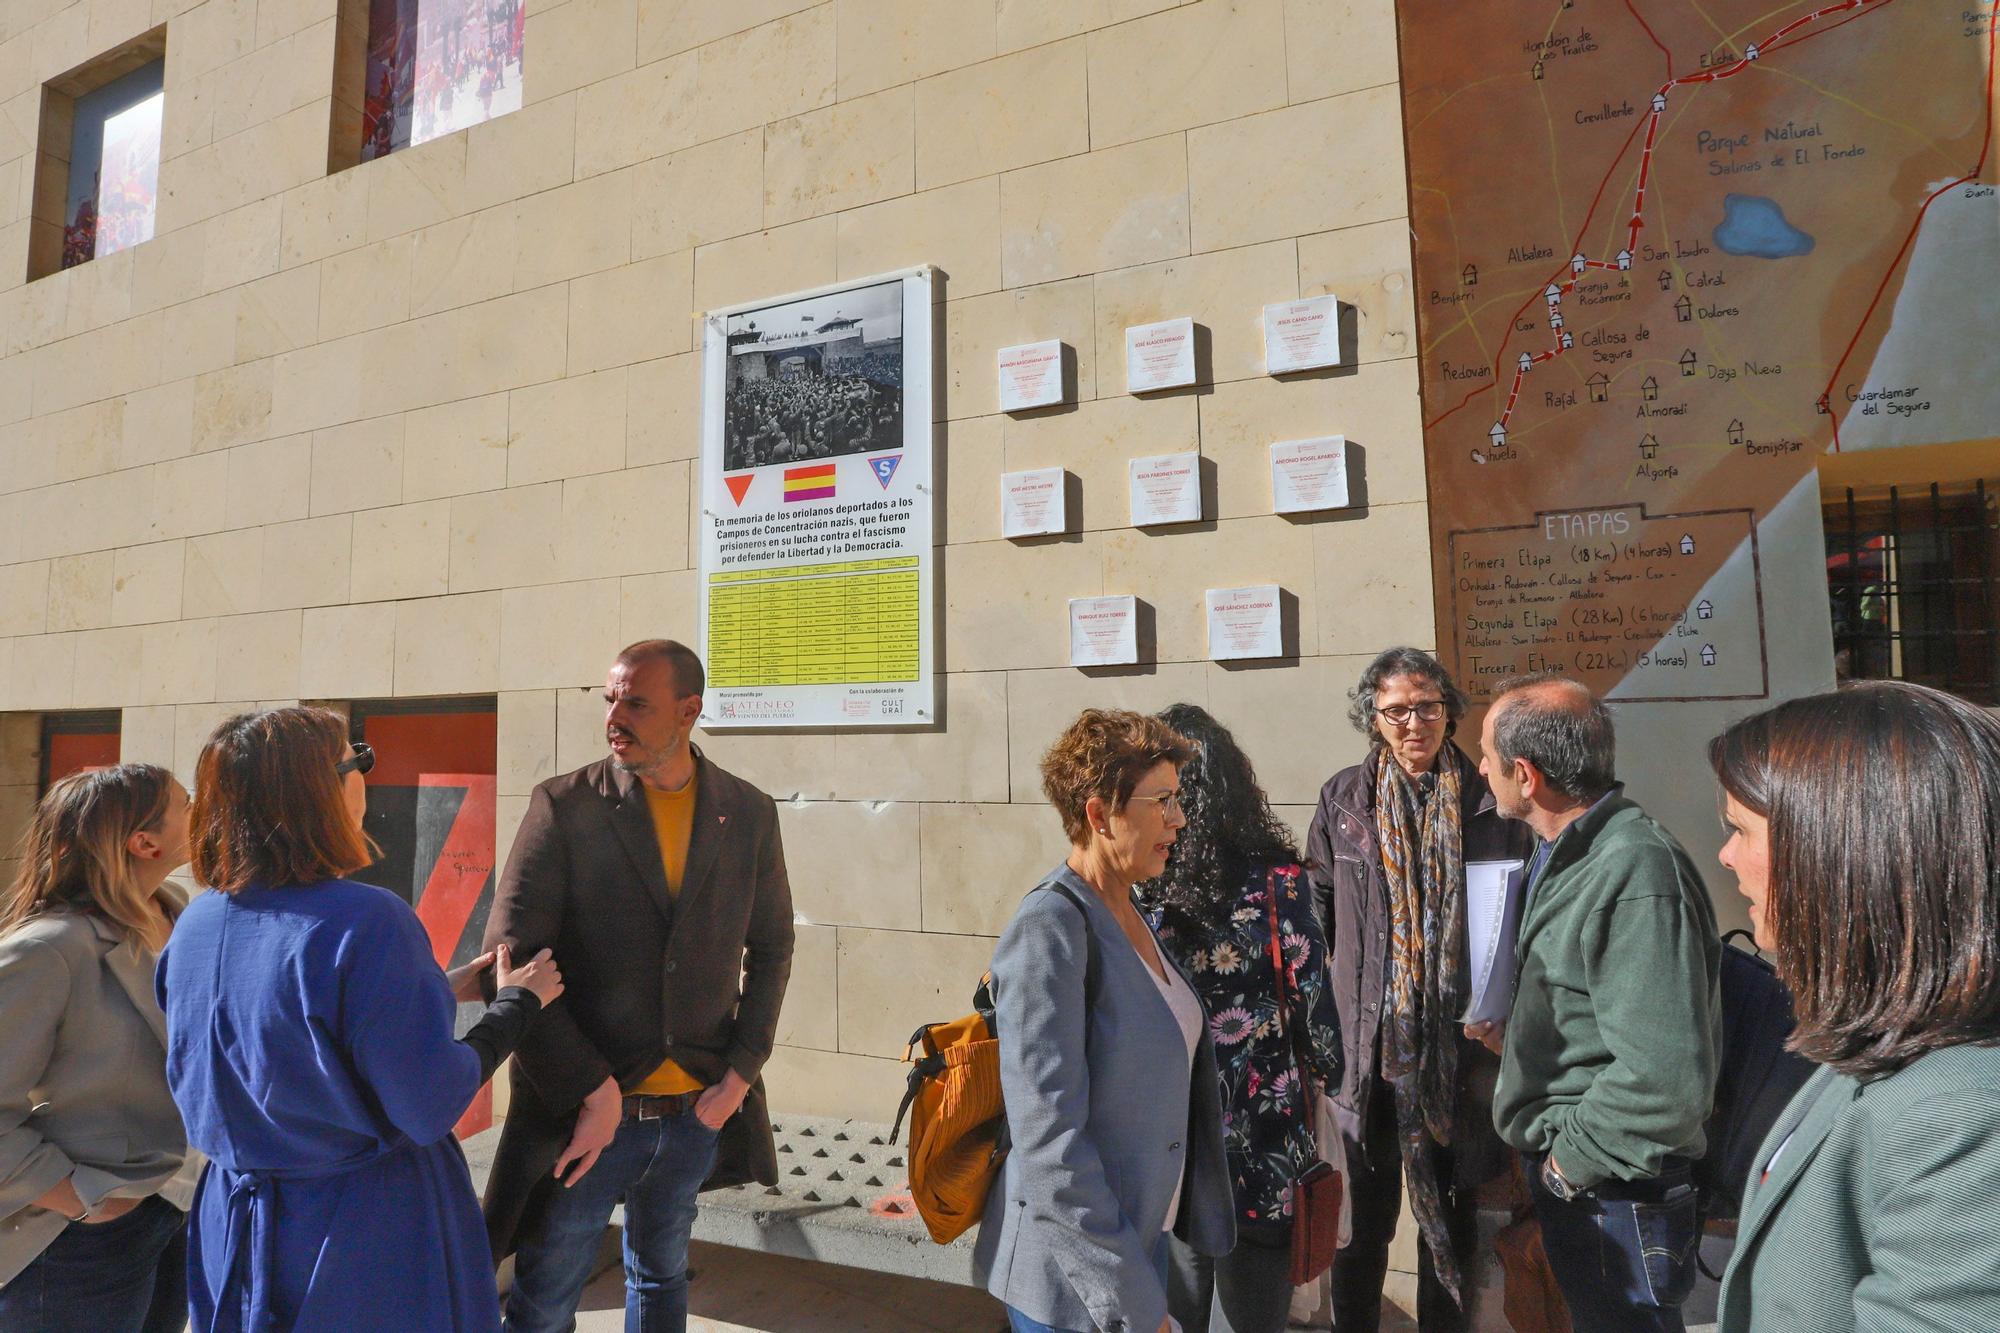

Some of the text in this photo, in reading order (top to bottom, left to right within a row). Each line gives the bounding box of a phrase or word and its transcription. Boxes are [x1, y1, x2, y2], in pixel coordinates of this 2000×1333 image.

[1576, 26, 1592, 42] de
[1700, 51, 1735, 68] Elche
[1575, 100, 1635, 125] Crevillente
[1696, 121, 1822, 155] Parque Natural
[1709, 143, 1866, 176] Salinas de El Fondo
[1964, 187, 1995, 199] Santa
[1507, 244, 1553, 264] Albatera
[1642, 240, 1710, 262] San Isidro
[1574, 277, 1630, 296] Granja de
[1684, 270, 1726, 288] Catral
[1431, 289, 1475, 306] Benferri
[1579, 291, 1632, 305] Rocamora
[1697, 304, 1739, 320] Dolores
[1515, 318, 1536, 332] Cox
[1582, 324, 1650, 347] Callosa de
[1592, 350, 1633, 365] Segura
[1707, 362, 1784, 382] Daya Nueva
[1545, 390, 1578, 408] Rafal
[1845, 384, 1919, 402] Guardamar
[1862, 400, 1930, 418] del Segura
[879, 461, 891, 477] S
[1636, 465, 1679, 481] Algorfa
[714, 518, 725, 527] En
[726, 513, 763, 527] memoria
[764, 512, 776, 522] de
[777, 510, 791, 520] los
[792, 506, 834, 519] oriolanos
[836, 501, 888, 517] deportados
[899, 497, 913, 507] los
[717, 511, 910, 542] Campos de Concentración nazis, que fueron
[1544, 511, 1630, 541] ETAPAS
[720, 525, 906, 553] prisioneros en su lucha contra el fascismo
[721, 539, 904, 565] por defender la Libertad y la Democracia.
[1462, 551, 1505, 570] Primera
[1518, 548, 1552, 570] Etapa
[1571, 545, 1590, 563] (18
[1639, 542, 1672, 558] horas)
[1466, 614, 1514, 633] Segunda
[1523, 610, 1558, 631] Etapa
[1572, 607, 1600, 627] (28
[1467, 656, 1516, 674] Tercera
[1528, 652, 1564, 673] Etapa
[1574, 650, 1604, 673] (22
[1655, 649, 1688, 669] horas)
[738, 700, 794, 709] ATENEO
